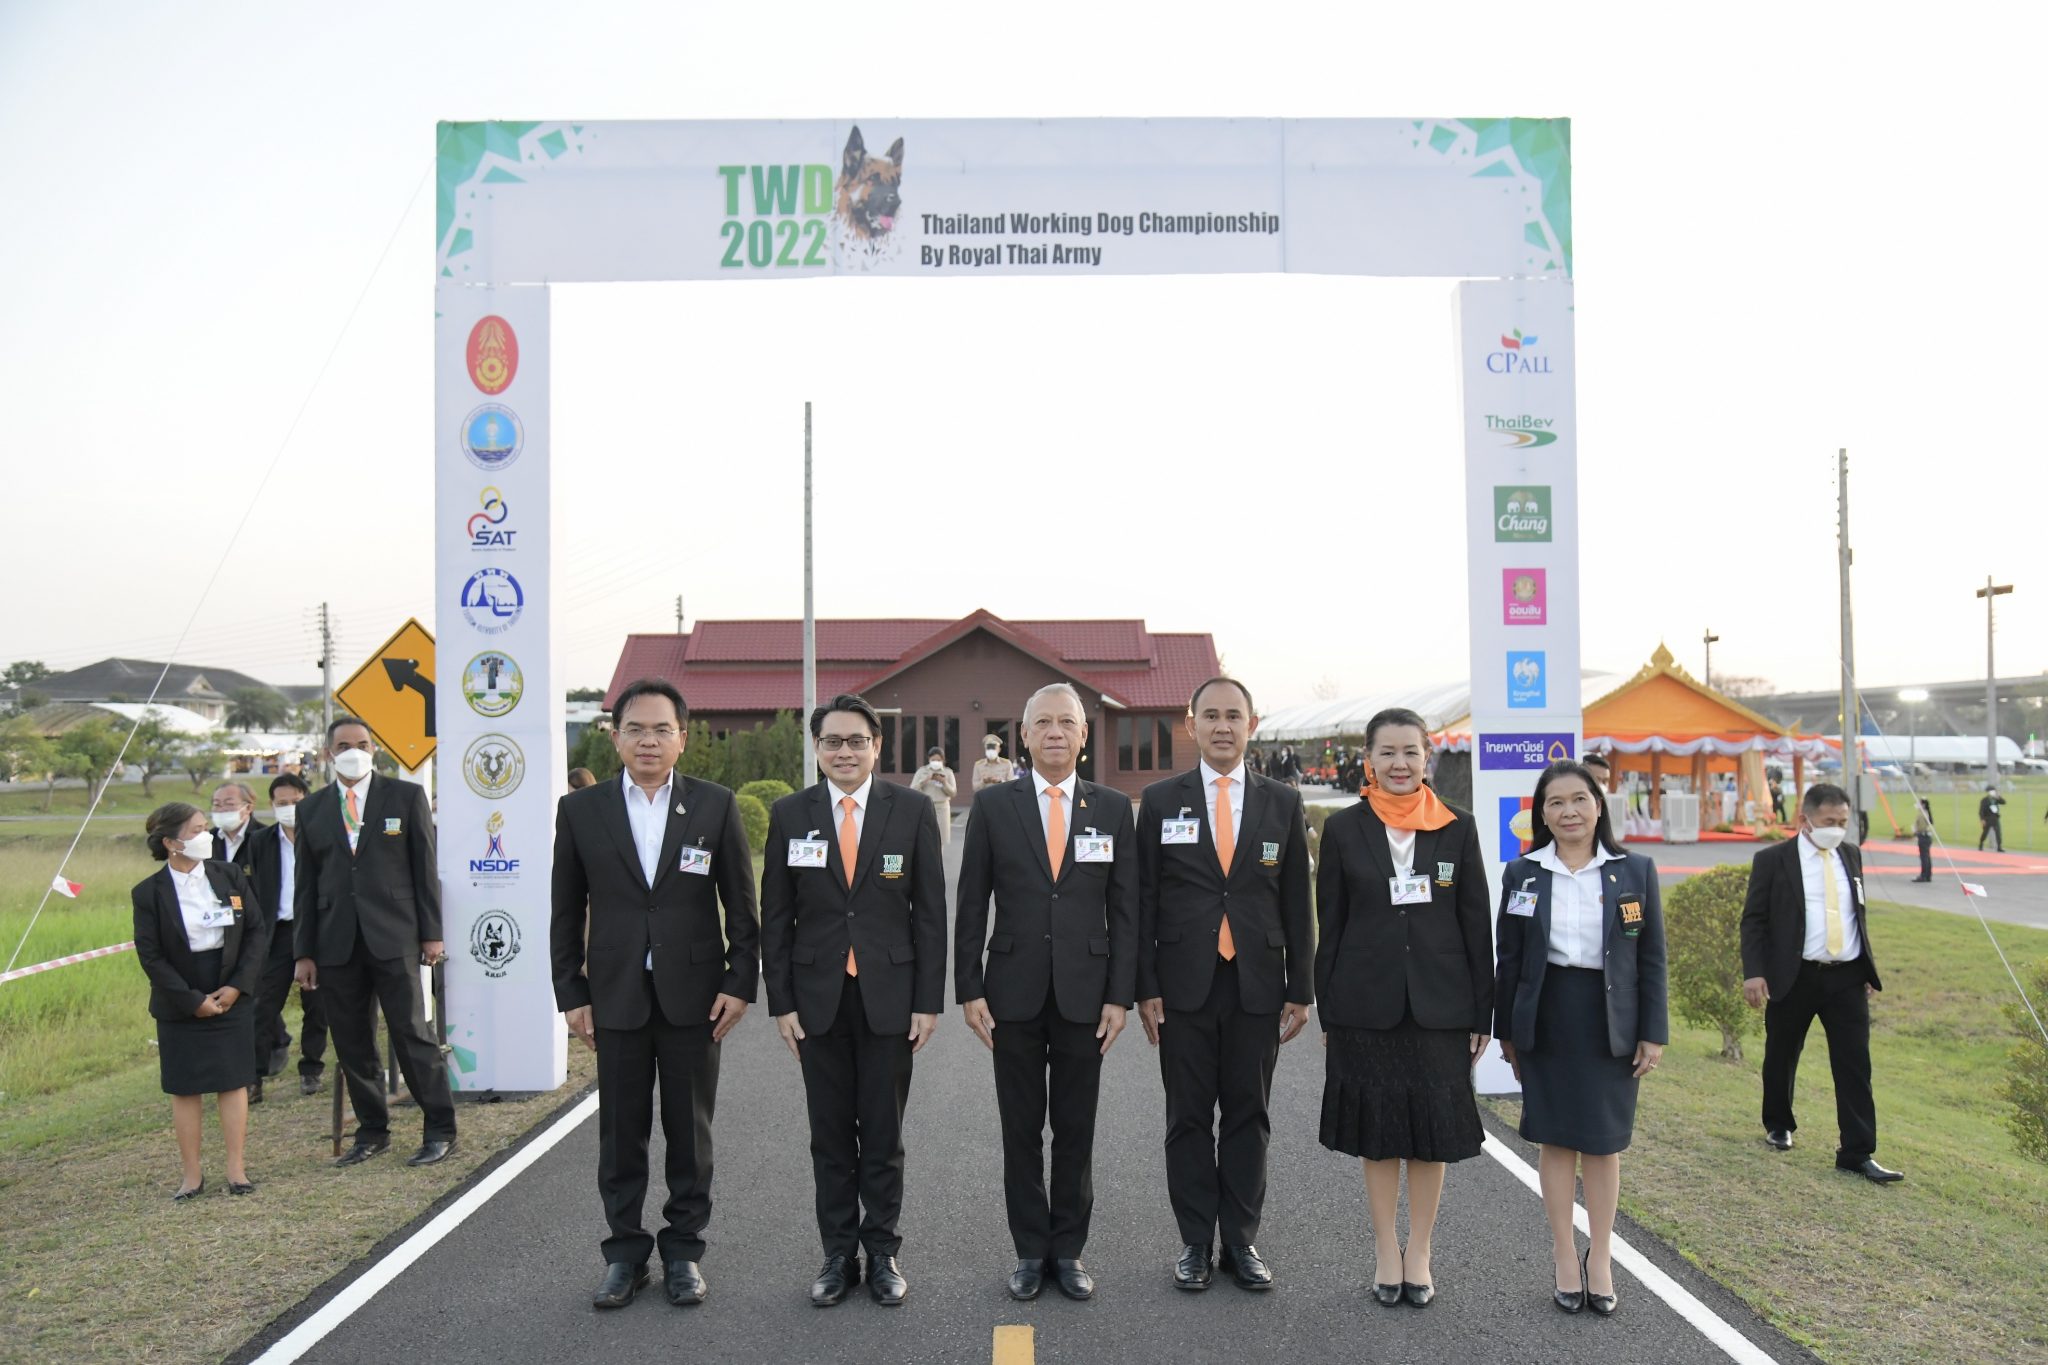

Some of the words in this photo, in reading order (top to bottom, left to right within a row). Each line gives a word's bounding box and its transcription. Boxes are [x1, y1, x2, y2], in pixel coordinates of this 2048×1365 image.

[719, 164, 833, 216] TWD
[921, 214, 1005, 234] Thailand
[1010, 213, 1092, 235] Working
[1097, 213, 1134, 235] Dog
[1139, 212, 1280, 234] Championship
[720, 219, 827, 268] 2022
[921, 245, 944, 267] By
[948, 244, 1002, 265] Royal
[1006, 244, 1048, 265] Thai
[1052, 244, 1102, 266] Army
[1485, 415, 1553, 429] ThaiBev
[1498, 513, 1548, 534] Chang
[471, 530, 517, 546] SAT
[1485, 740, 1544, 753] ไทยพาณิชย์
[1523, 753, 1544, 763] SCB
[469, 859, 520, 872] NSDF
